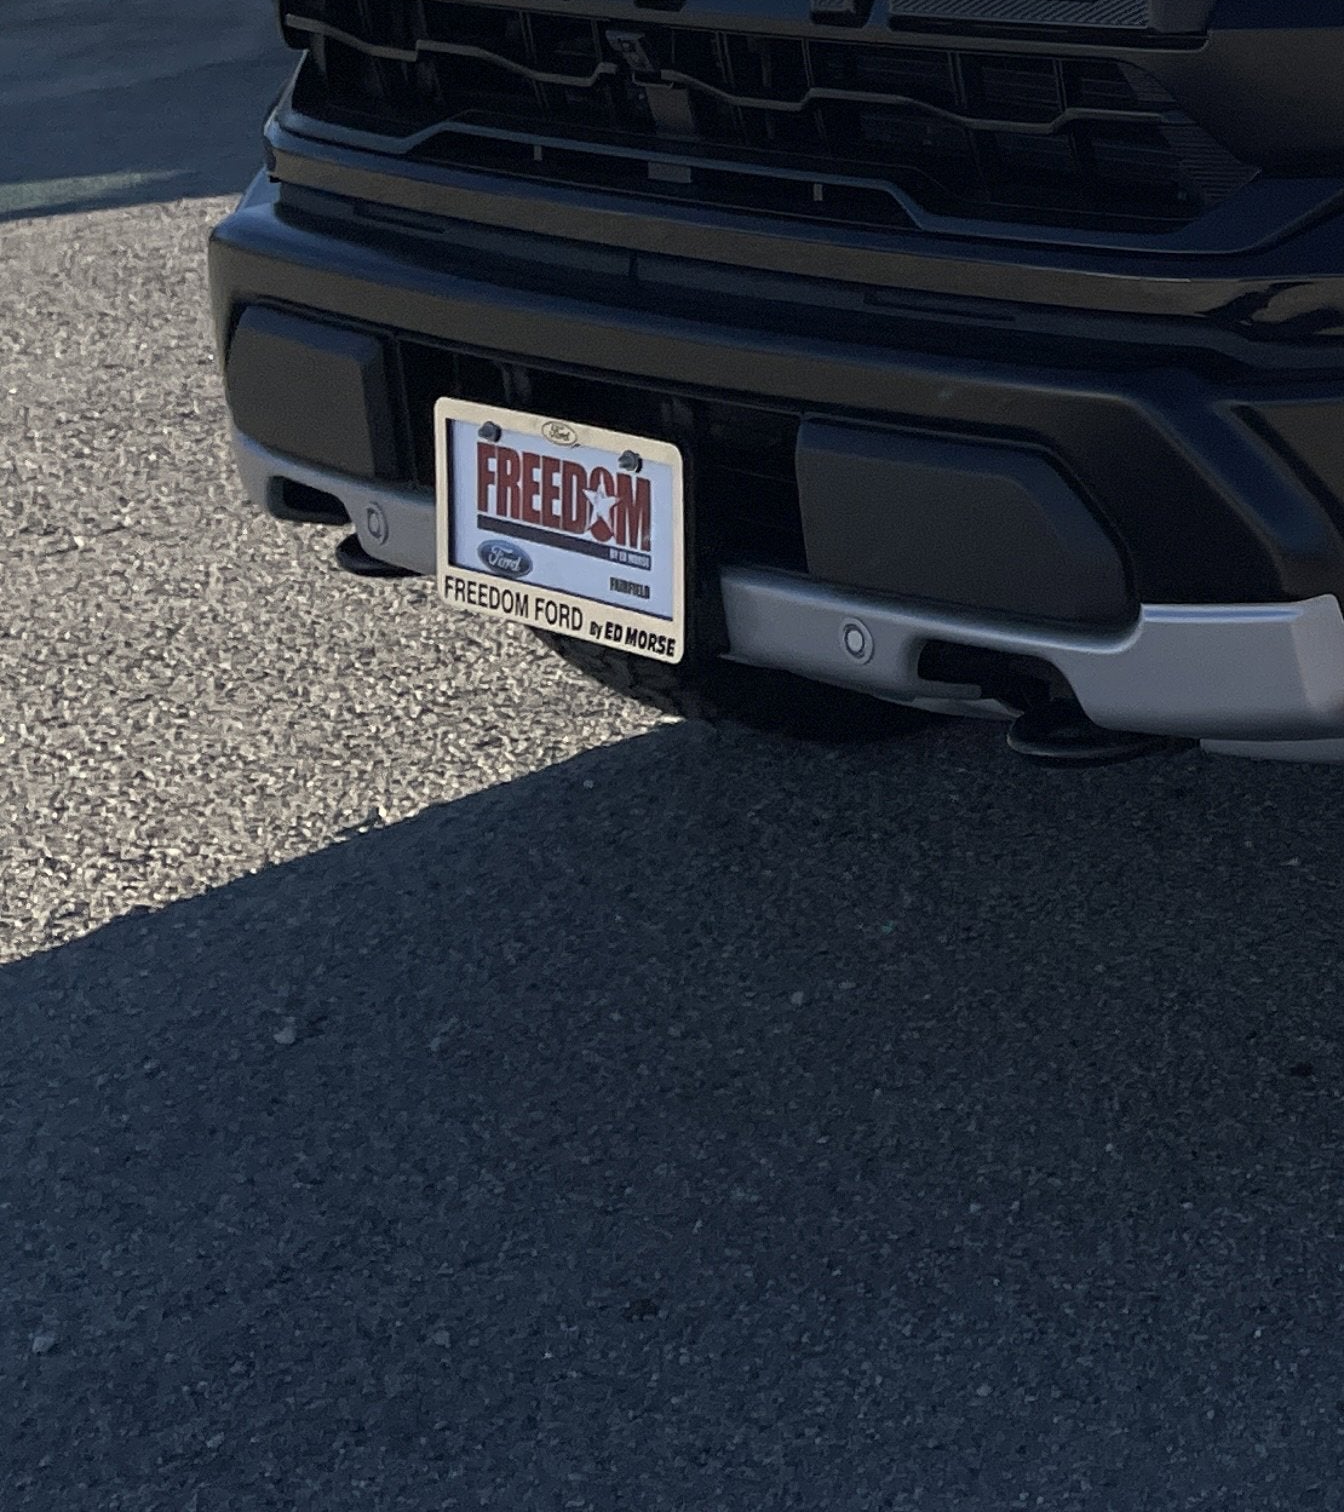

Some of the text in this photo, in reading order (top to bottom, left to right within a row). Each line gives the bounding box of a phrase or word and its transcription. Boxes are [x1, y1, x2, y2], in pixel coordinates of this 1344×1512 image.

[476, 441, 651, 552] FREEDOM
[445, 576, 529, 620] FREEDOM
[535, 597, 583, 631] FORD
[604, 620, 622, 641] ED
[624, 626, 676, 658] MORSE
